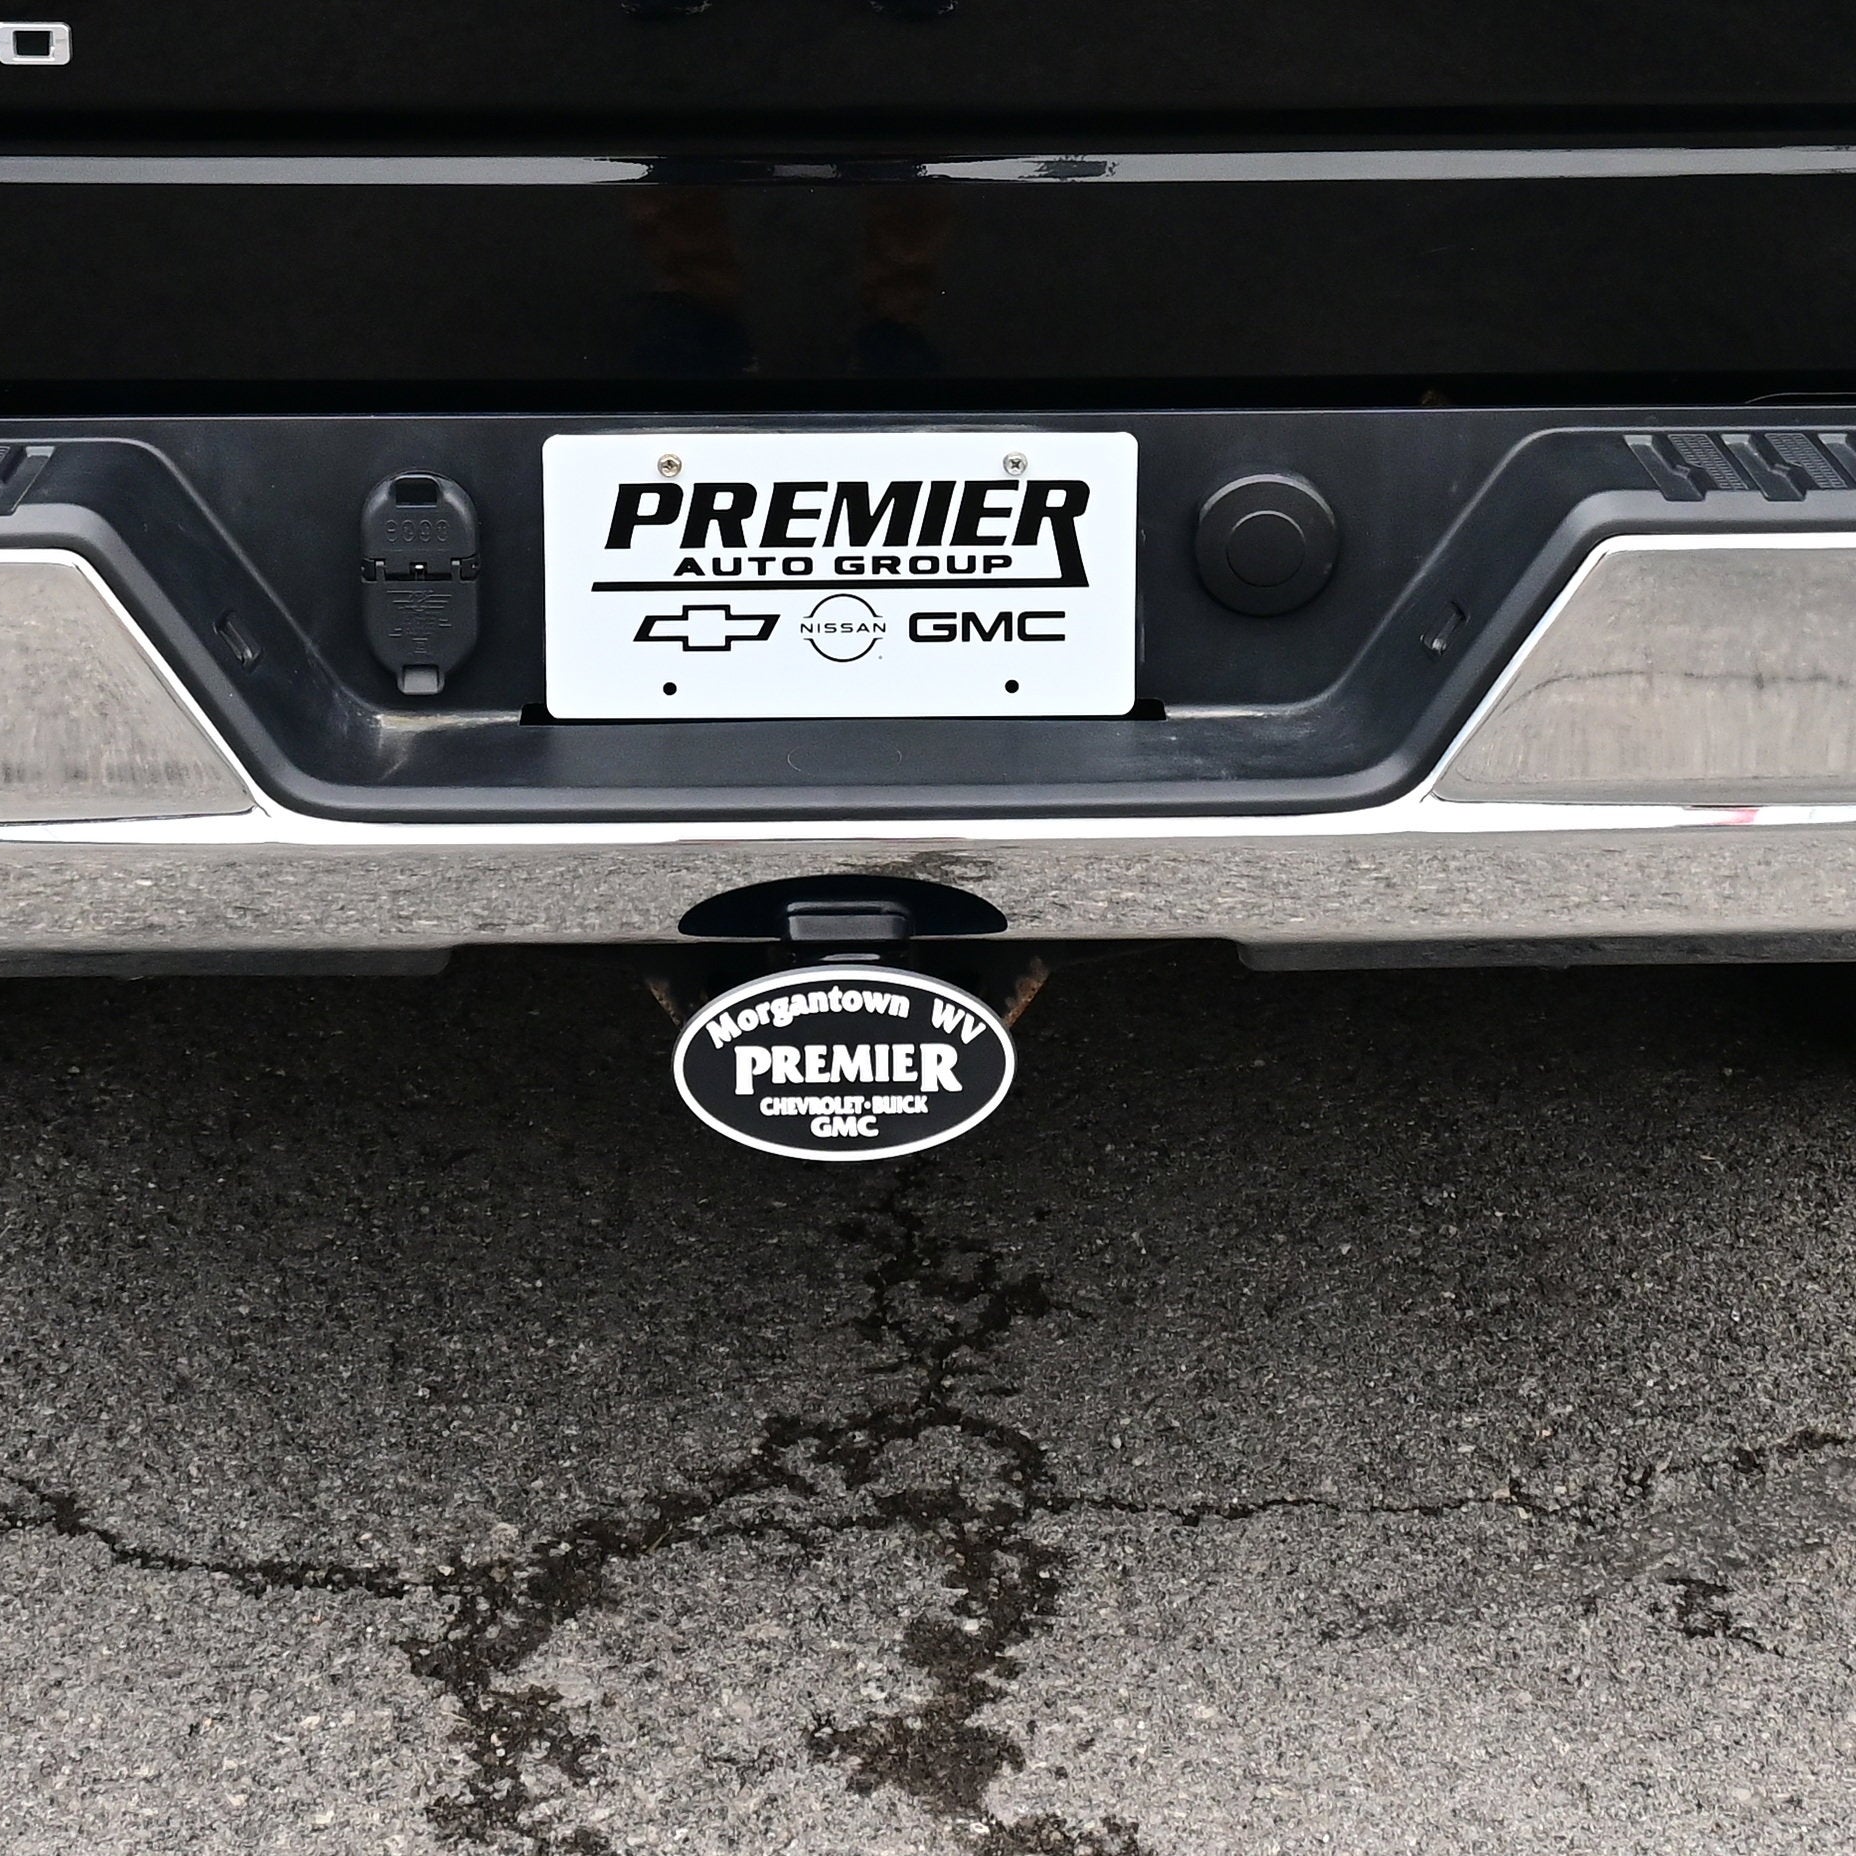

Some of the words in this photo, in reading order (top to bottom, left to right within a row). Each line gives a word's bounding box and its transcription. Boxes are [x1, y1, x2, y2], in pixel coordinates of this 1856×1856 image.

[605, 479, 1091, 549] PREMIER
[674, 556, 814, 578] AUTO
[834, 555, 1013, 576] GROUP
[800, 622, 886, 634] NISSAN
[908, 610, 1066, 643] GMC
[705, 985, 910, 1049] Morgantown
[931, 998, 987, 1046] WV
[734, 1042, 963, 1096] PREMIER
[811, 1115, 879, 1138] GMC
